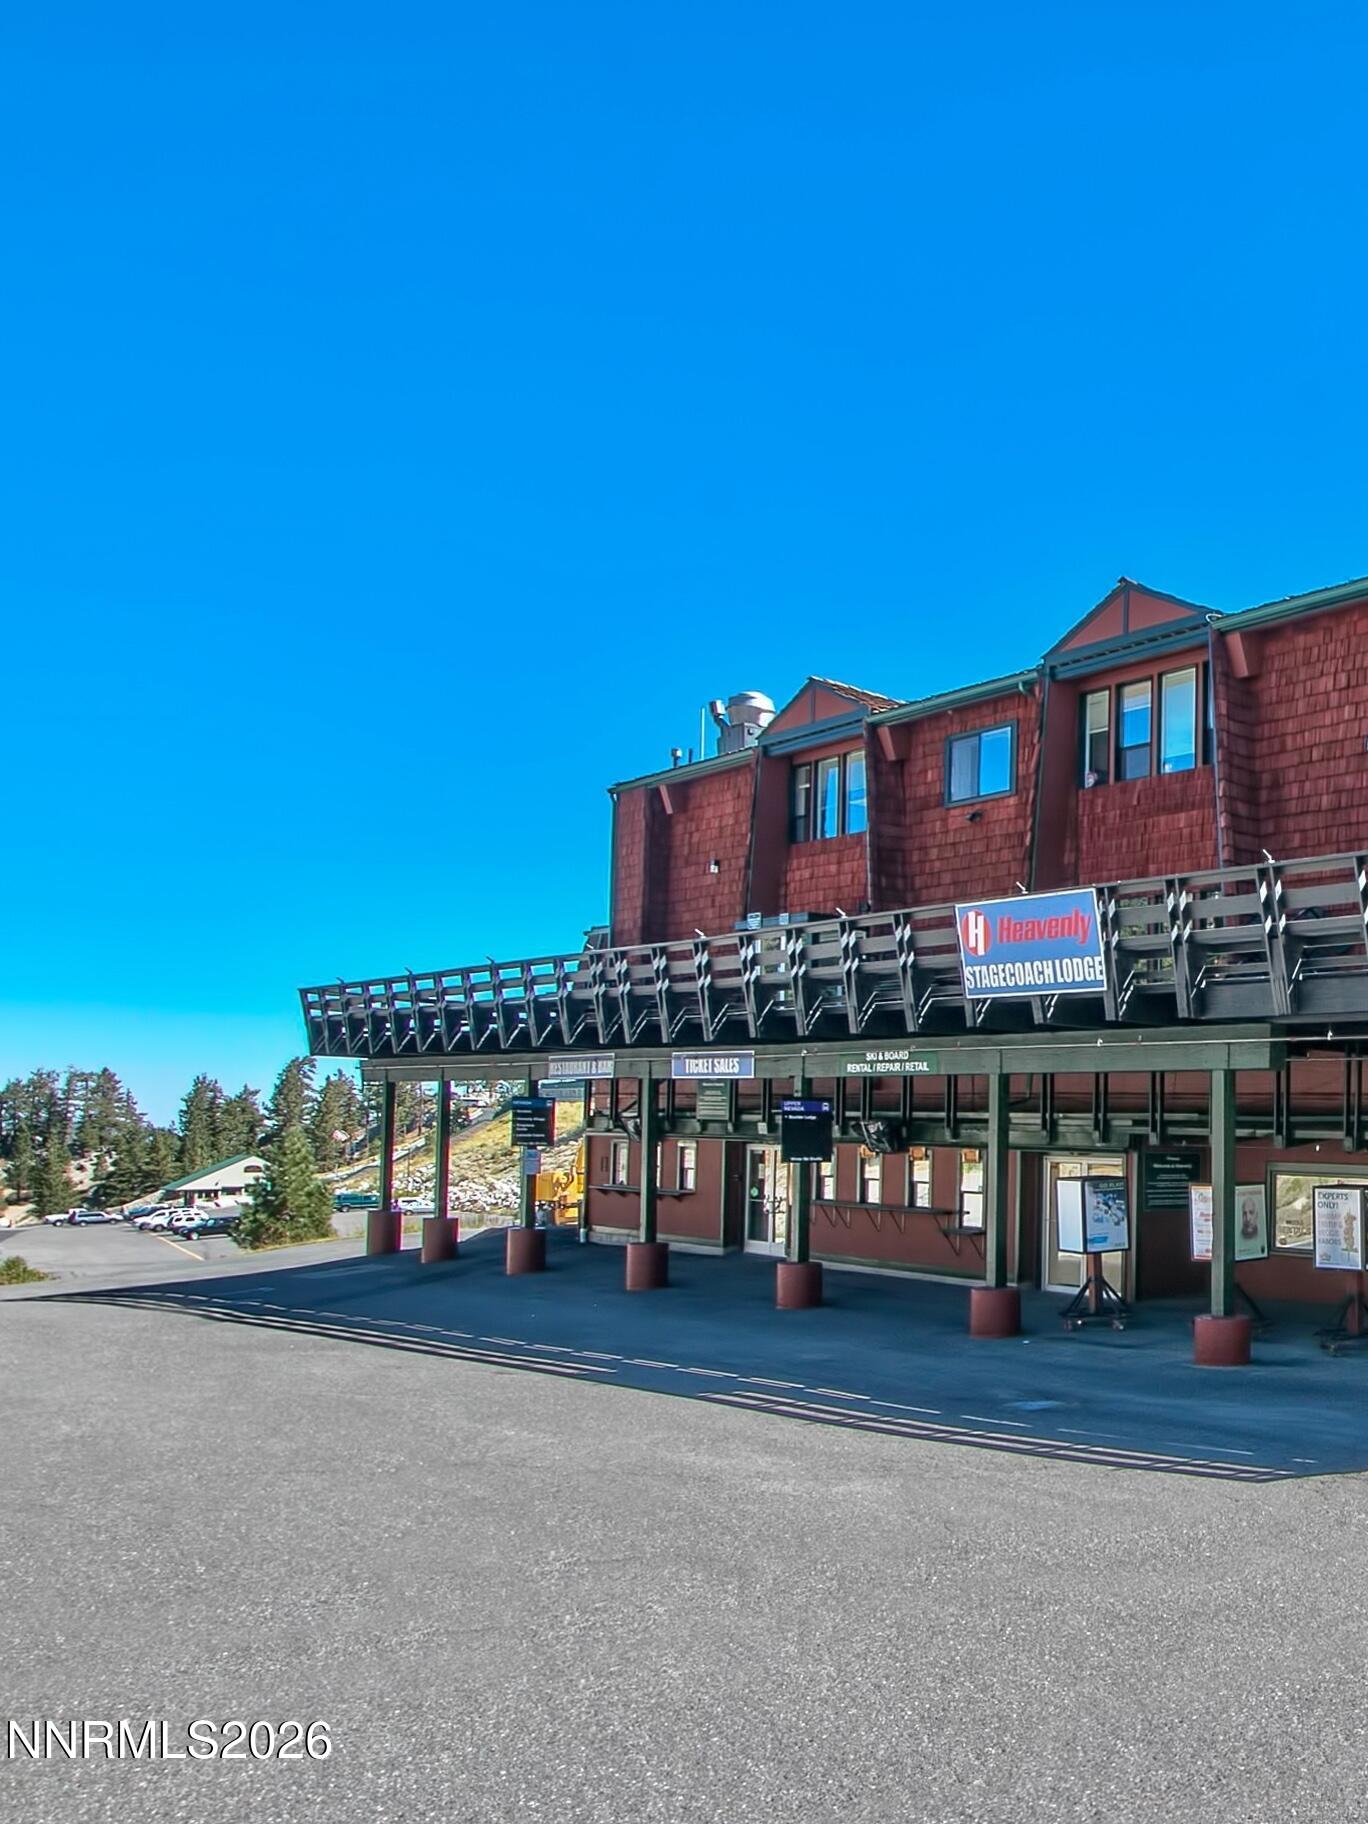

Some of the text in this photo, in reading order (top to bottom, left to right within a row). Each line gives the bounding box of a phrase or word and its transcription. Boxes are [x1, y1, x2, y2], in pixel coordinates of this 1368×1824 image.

[998, 908, 1091, 945] Heavenly
[965, 956, 1104, 989] STAGECOACH LODGE
[866, 1051, 909, 1061] SKI & BOARD
[685, 1057, 740, 1074] TICKET SALES
[847, 1063, 872, 1073] RENTAL
[876, 1062, 901, 1072] REPAIR
[905, 1061, 930, 1071] RETAIL
[1318, 1191, 1349, 1200] EXPERTS
[1317, 1201, 1339, 1209] ONLY!
